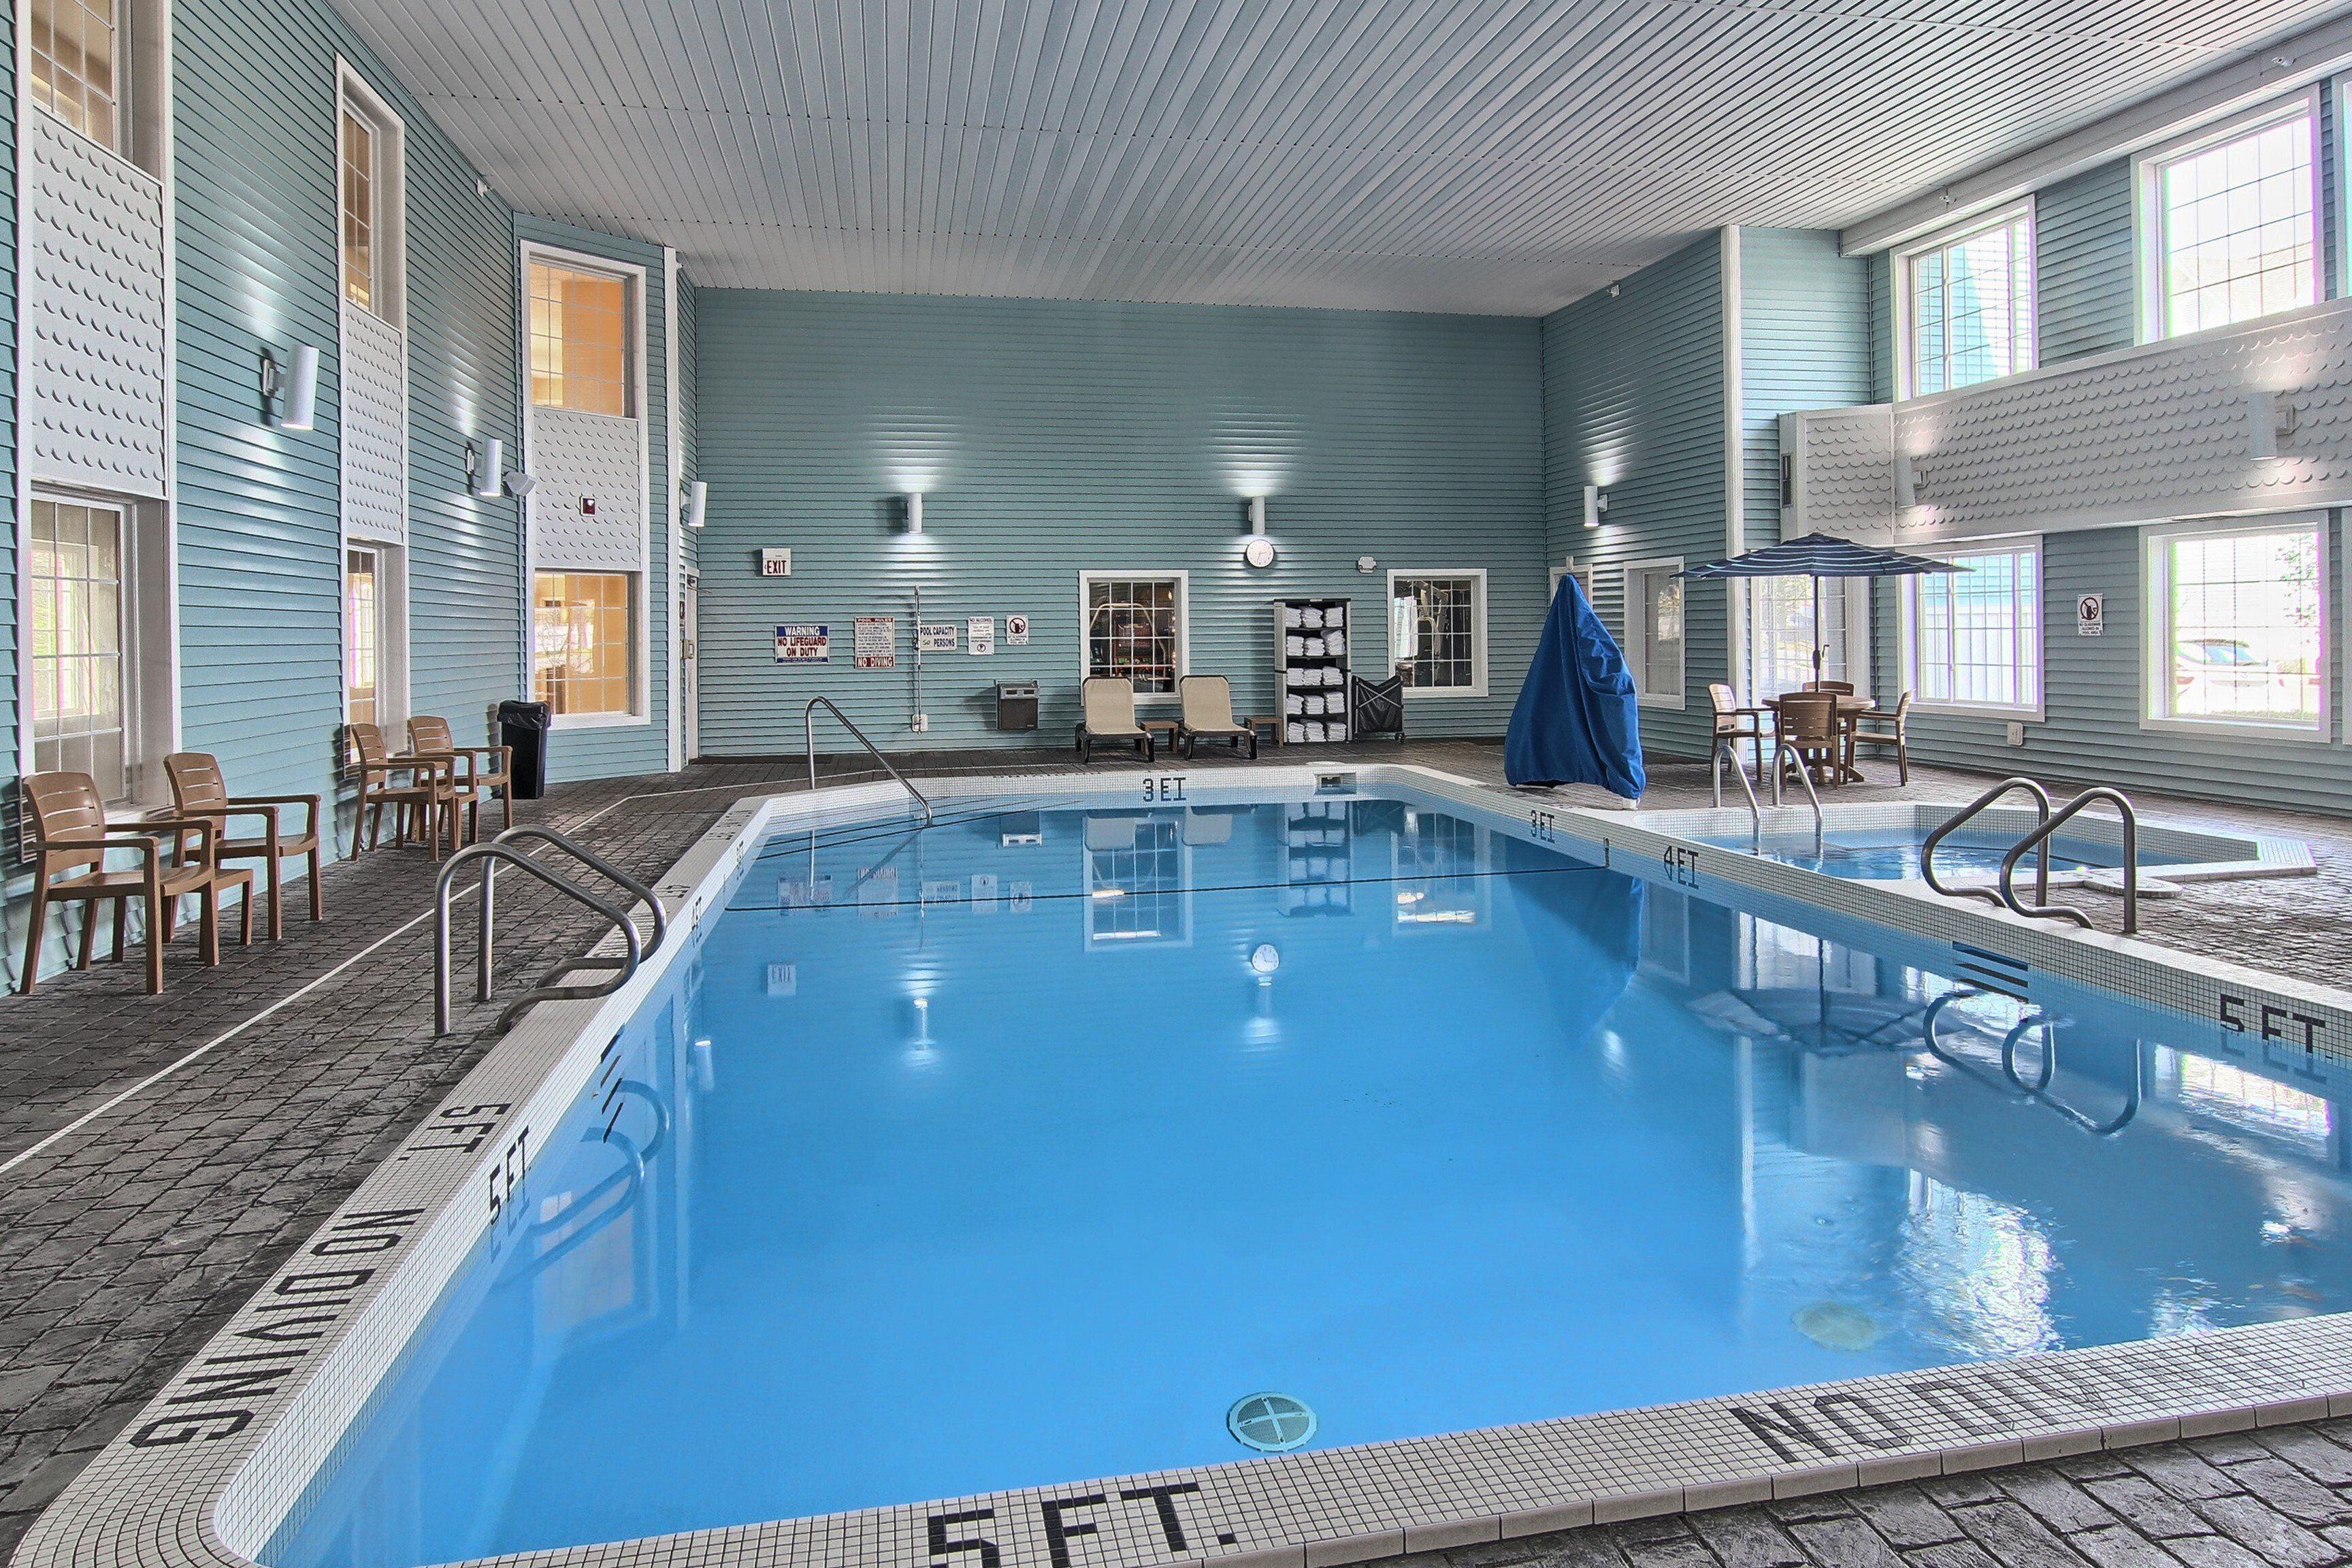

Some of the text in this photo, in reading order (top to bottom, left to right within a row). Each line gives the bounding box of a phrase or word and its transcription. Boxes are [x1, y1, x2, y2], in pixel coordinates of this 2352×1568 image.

[766, 560, 787, 574] EXIT
[785, 626, 820, 636] WARNING
[920, 626, 955, 636] POOL CAPACITY
[778, 637, 826, 646] NO LIFEGUARD
[934, 638, 955, 647] PERSONS
[786, 647, 818, 656] ON DUTY
[858, 657, 893, 667] NO DIVING
[128, 1207, 427, 1448] NO DIVING
[1727, 1393, 1911, 1463] NO
